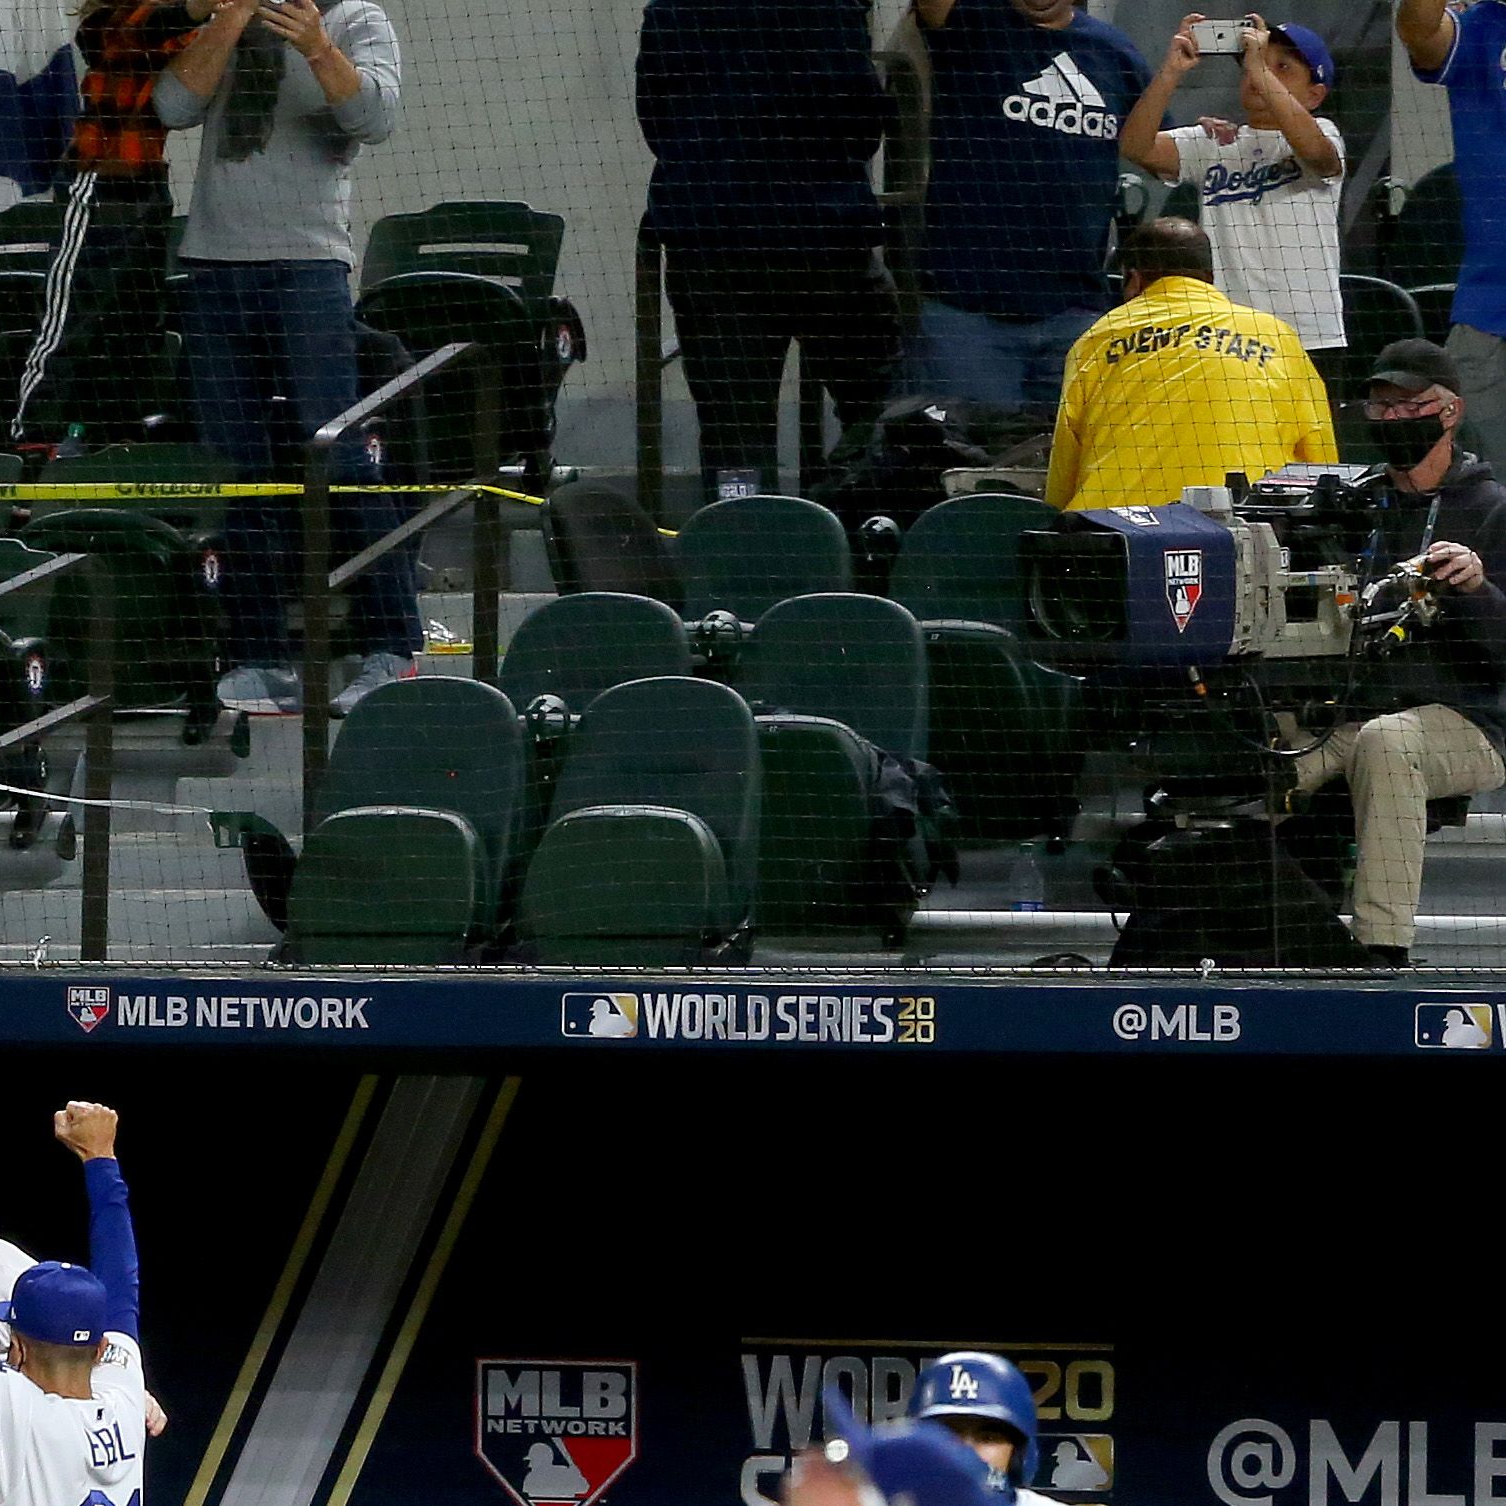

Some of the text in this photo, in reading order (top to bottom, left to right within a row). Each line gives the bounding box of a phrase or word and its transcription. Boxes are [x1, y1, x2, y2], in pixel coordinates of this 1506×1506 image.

[1106, 324, 1276, 368] EVENT STAFF
[1167, 554, 1199, 577] MLB
[70, 989, 107, 1001] MLB
[117, 995, 370, 1029] MLB NETWORK
[642, 993, 936, 1044] WORLD SERIES 20
[898, 1020, 936, 1043] 20
[1112, 1003, 1241, 1042] @MLB
[487, 1369, 628, 1419] MLB
[949, 1364, 979, 1400] LA
[487, 1419, 627, 1436] NETWORK
